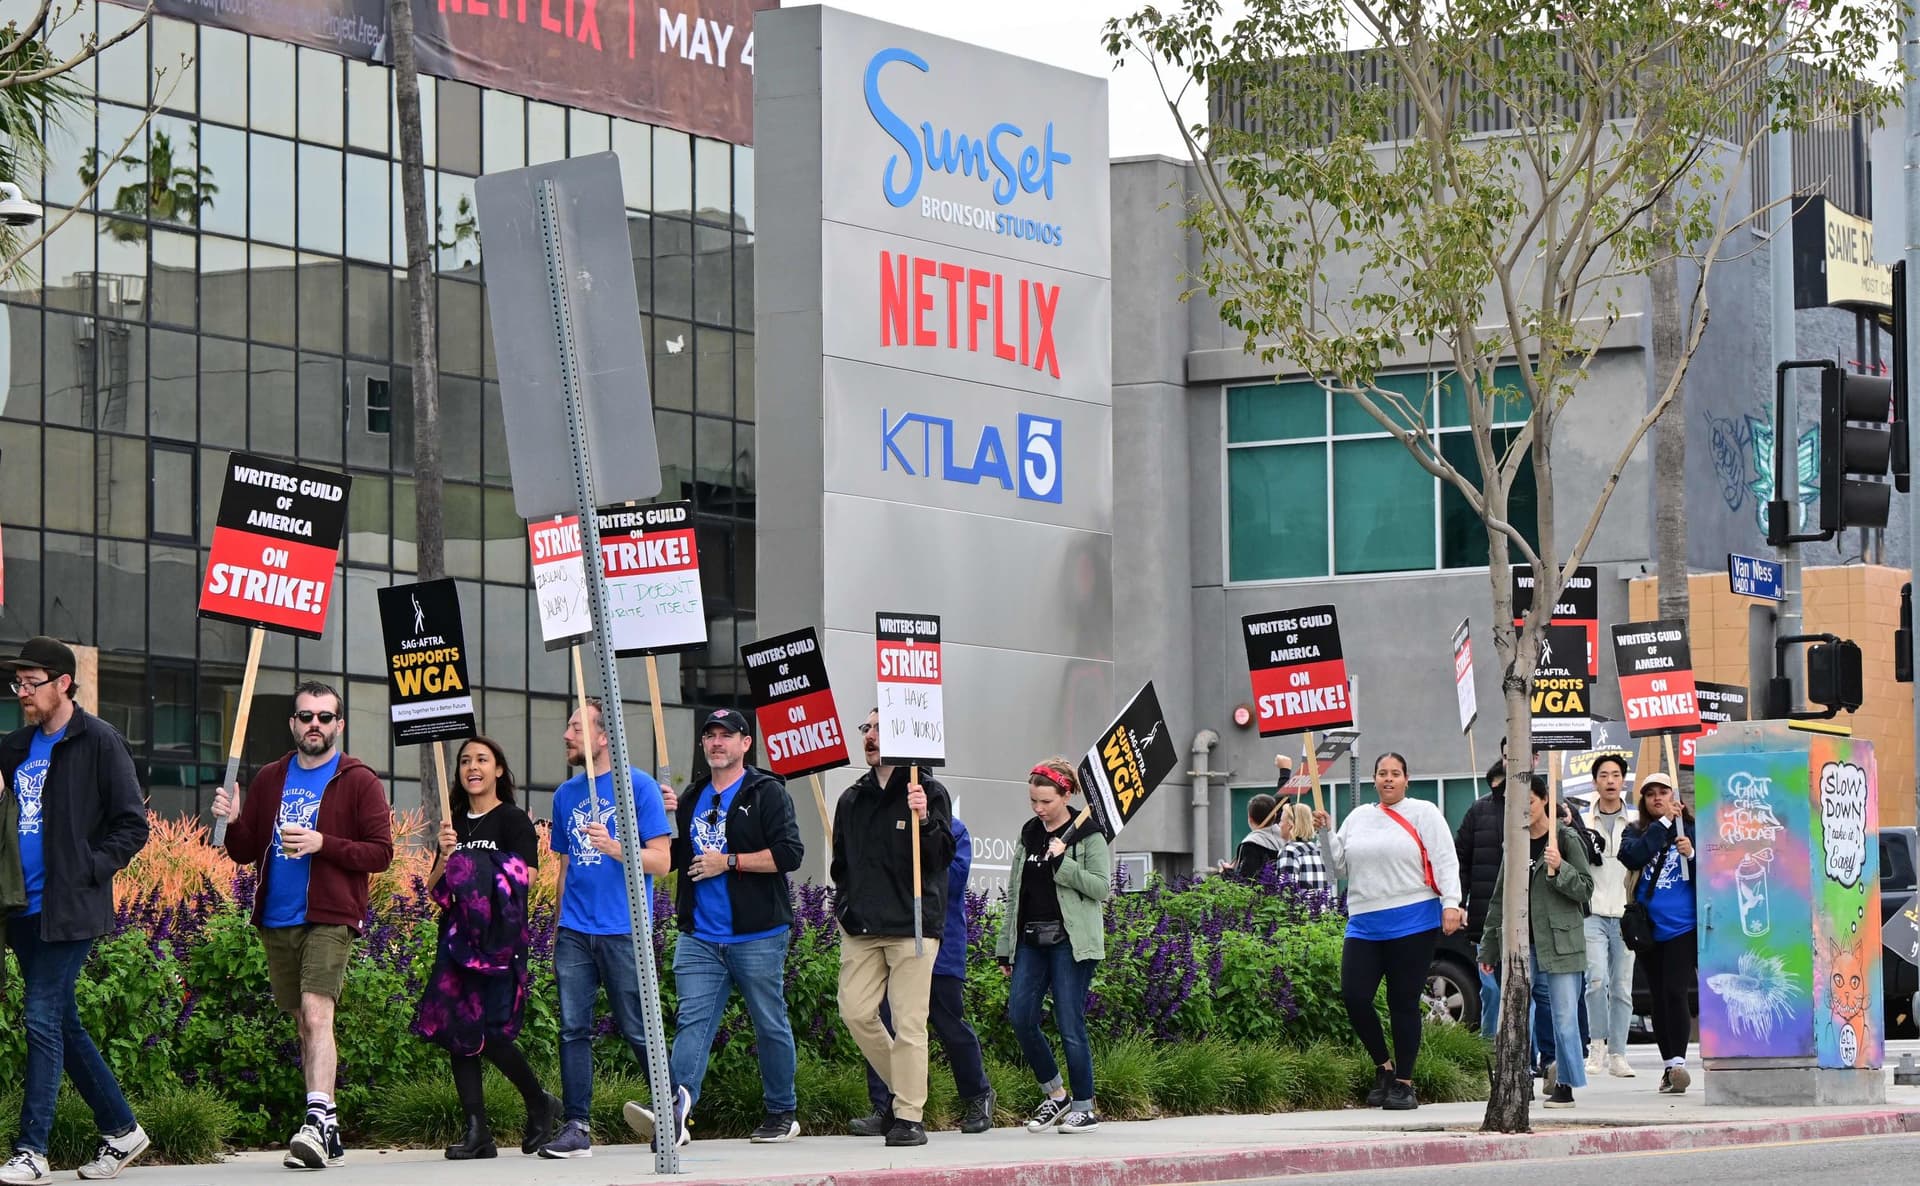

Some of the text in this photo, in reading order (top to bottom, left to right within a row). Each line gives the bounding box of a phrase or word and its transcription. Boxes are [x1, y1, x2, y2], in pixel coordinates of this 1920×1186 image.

[660, 8, 734, 68] MAY
[1828, 222, 1858, 264] SAME
[880, 250, 1062, 380] NETFLIX
[880, 408, 1056, 496] KTLA 5
[234, 465, 344, 502] WRITERS GUILD
[276, 496, 293, 511] OF
[246, 509, 313, 537] AMERICA
[598, 507, 687, 530] RITERS GUILD
[629, 529, 644, 540] ON
[261, 547, 289, 569] ON
[600, 536, 692, 573] TRIKE!
[1733, 557, 1773, 582] Van Ness
[208, 563, 326, 615] STRIKE!
[1735, 577, 1749, 592] 1400
[1750, 580, 1755, 592] N
[611, 600, 698, 618] RITE ITSELF
[1553, 604, 1577, 614] RICA
[879, 618, 938, 636] WRITERS GUILD
[1248, 614, 1332, 636] WRITERS GUILD
[1286, 634, 1299, 644] OF
[1617, 630, 1682, 646] WRITERS GUILD
[392, 647, 460, 669] SUPPORTS
[746, 638, 815, 668] WRITERS GUILD
[1270, 645, 1320, 663] AMERICA
[1647, 646, 1657, 655] OF
[778, 663, 789, 675] OF
[880, 648, 938, 679] STRIKE!
[1635, 656, 1674, 670] AMERICA
[394, 664, 463, 697] WGA
[768, 674, 811, 697] AMERICA
[1289, 671, 1310, 687] ON
[1534, 679, 1584, 690] PPORTS
[1651, 679, 1667, 692] ON
[904, 688, 928, 710] HAVE
[1259, 684, 1347, 719] STRIKE!
[1627, 692, 1695, 720] STRIKE!
[1696, 690, 1744, 703] RITERS GUILD
[1710, 702, 1719, 710] OF
[788, 705, 806, 723] ON
[768, 717, 841, 761] STRIKE!
[891, 717, 942, 743] NO WORDS
[24, 760, 48, 771] GUILD
[1116, 725, 1145, 799] SUPPORTS
[1103, 733, 1135, 815] WGA
[305, 790, 316, 799] OF
[1832, 824, 1846, 840] take
[973, 837, 1017, 860] DSON
[1830, 845, 1855, 879] Easy
[969, 876, 1007, 892] ACIFI
